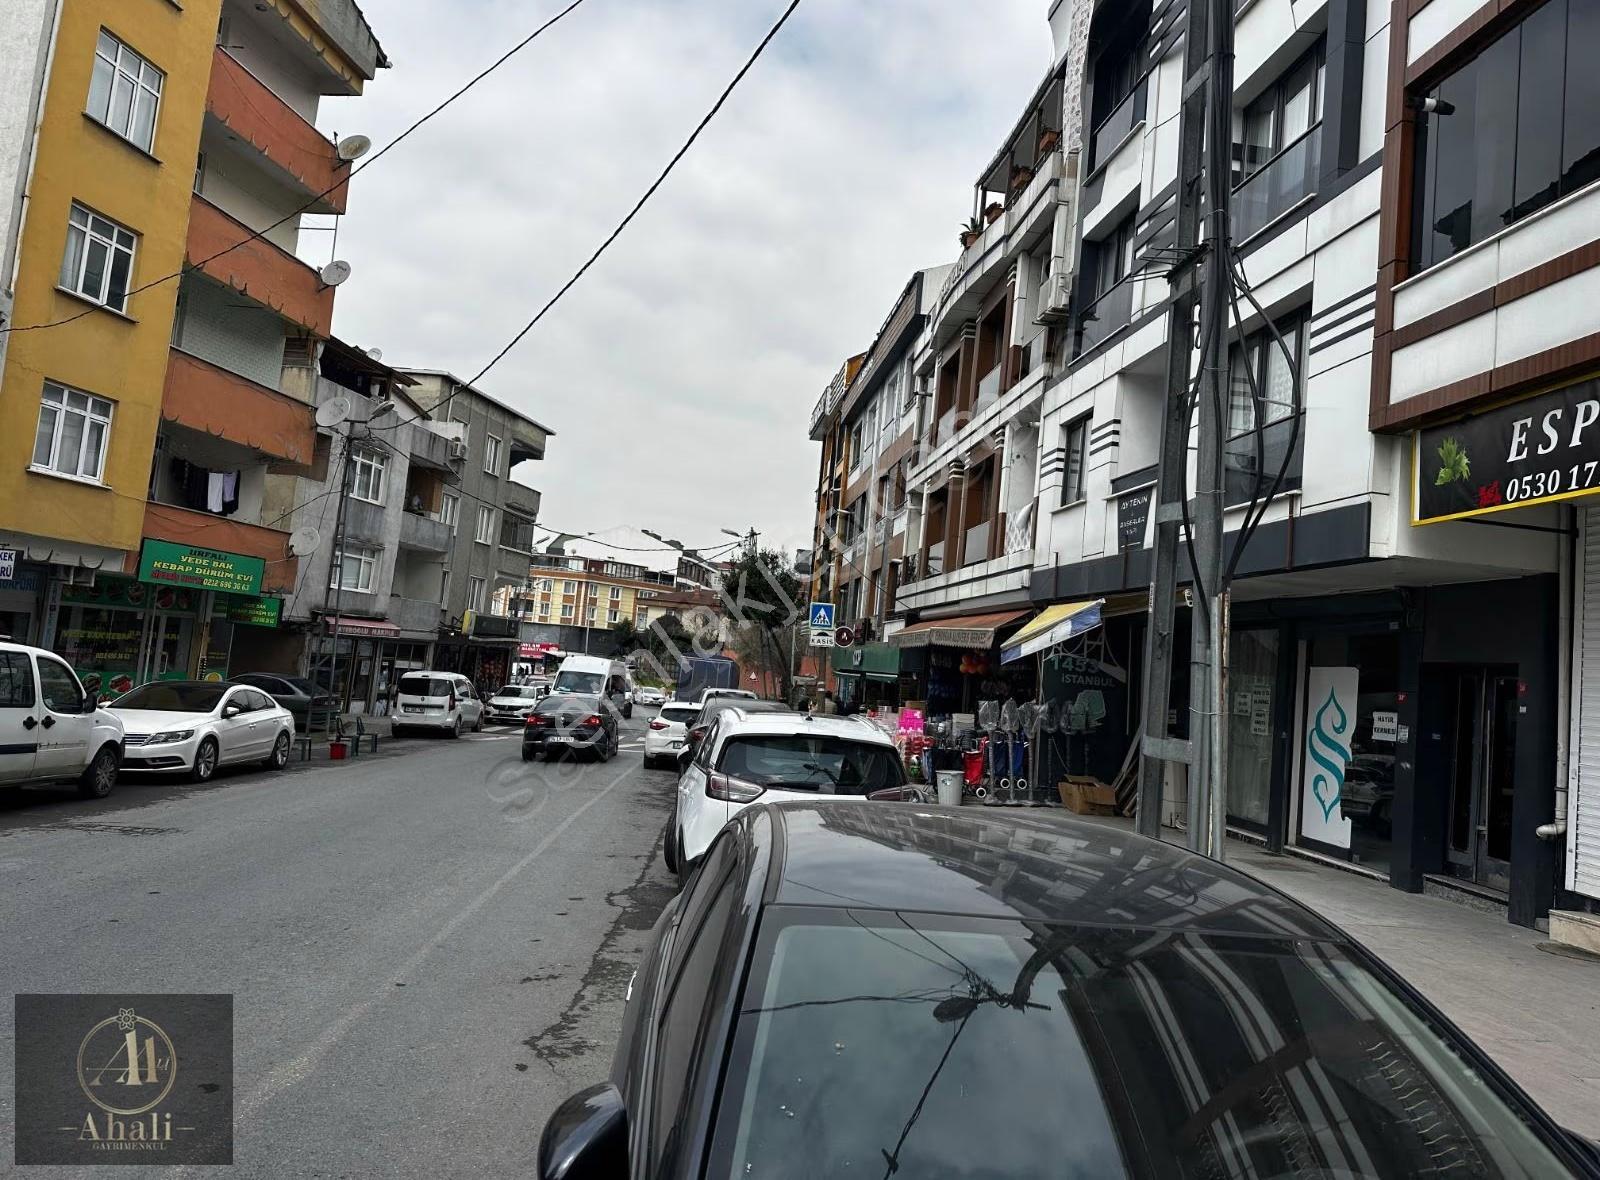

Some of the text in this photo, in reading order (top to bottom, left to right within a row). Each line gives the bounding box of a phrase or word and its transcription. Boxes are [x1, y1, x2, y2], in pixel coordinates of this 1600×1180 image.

[1506, 461, 1600, 502] 0530 17
[0, 565, 12, 578] RÜ
[153, 561, 193, 573] KEBAP
[195, 567, 234, 579] DÜRÜM
[212, 560, 234, 570] BAK
[1050, 655, 1099, 674] 1453
